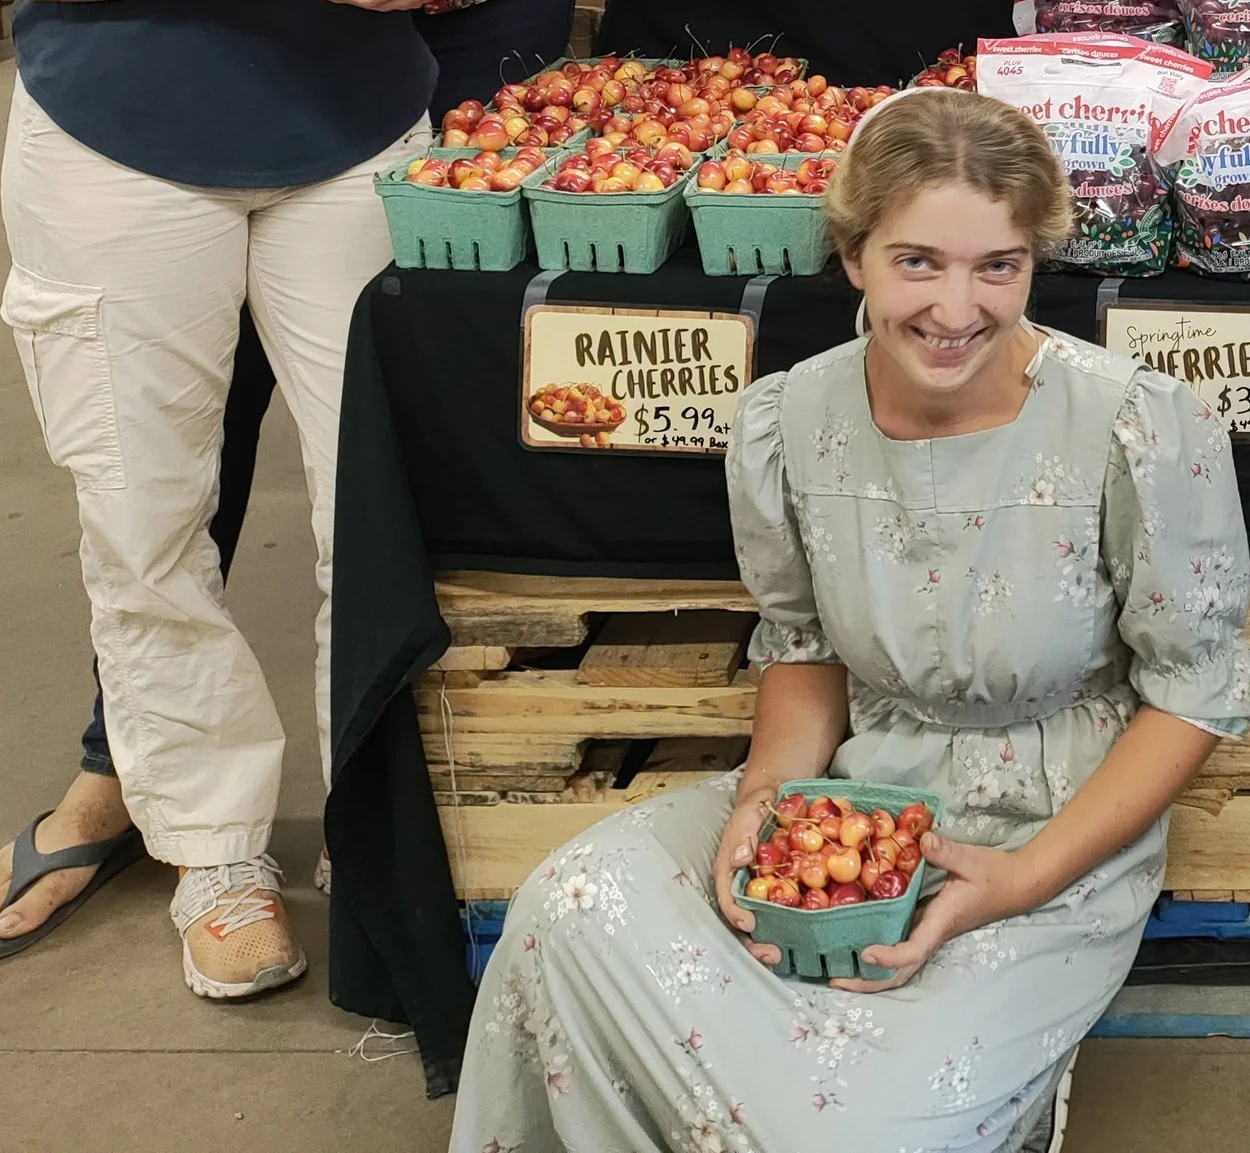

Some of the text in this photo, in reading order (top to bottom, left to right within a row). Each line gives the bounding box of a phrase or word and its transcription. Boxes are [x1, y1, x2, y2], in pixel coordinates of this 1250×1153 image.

[1059, 1, 1150, 16] cerises douces
[1091, 50, 1119, 58] douces
[997, 66, 1024, 77] 4045
[1138, 54, 1195, 74] sweet cherries
[1170, 71, 1185, 81] story
[1063, 158, 1106, 175] grown
[1077, 183, 1133, 199] douces
[1178, 191, 1229, 213] cerises
[1126, 317, 1217, 353] Springtime
[574, 327, 712, 367] RAINIER
[611, 364, 739, 400] CHERRIES
[633, 403, 731, 444] $5.99 at
[645, 436, 657, 445] or
[709, 436, 729, 449] Box
